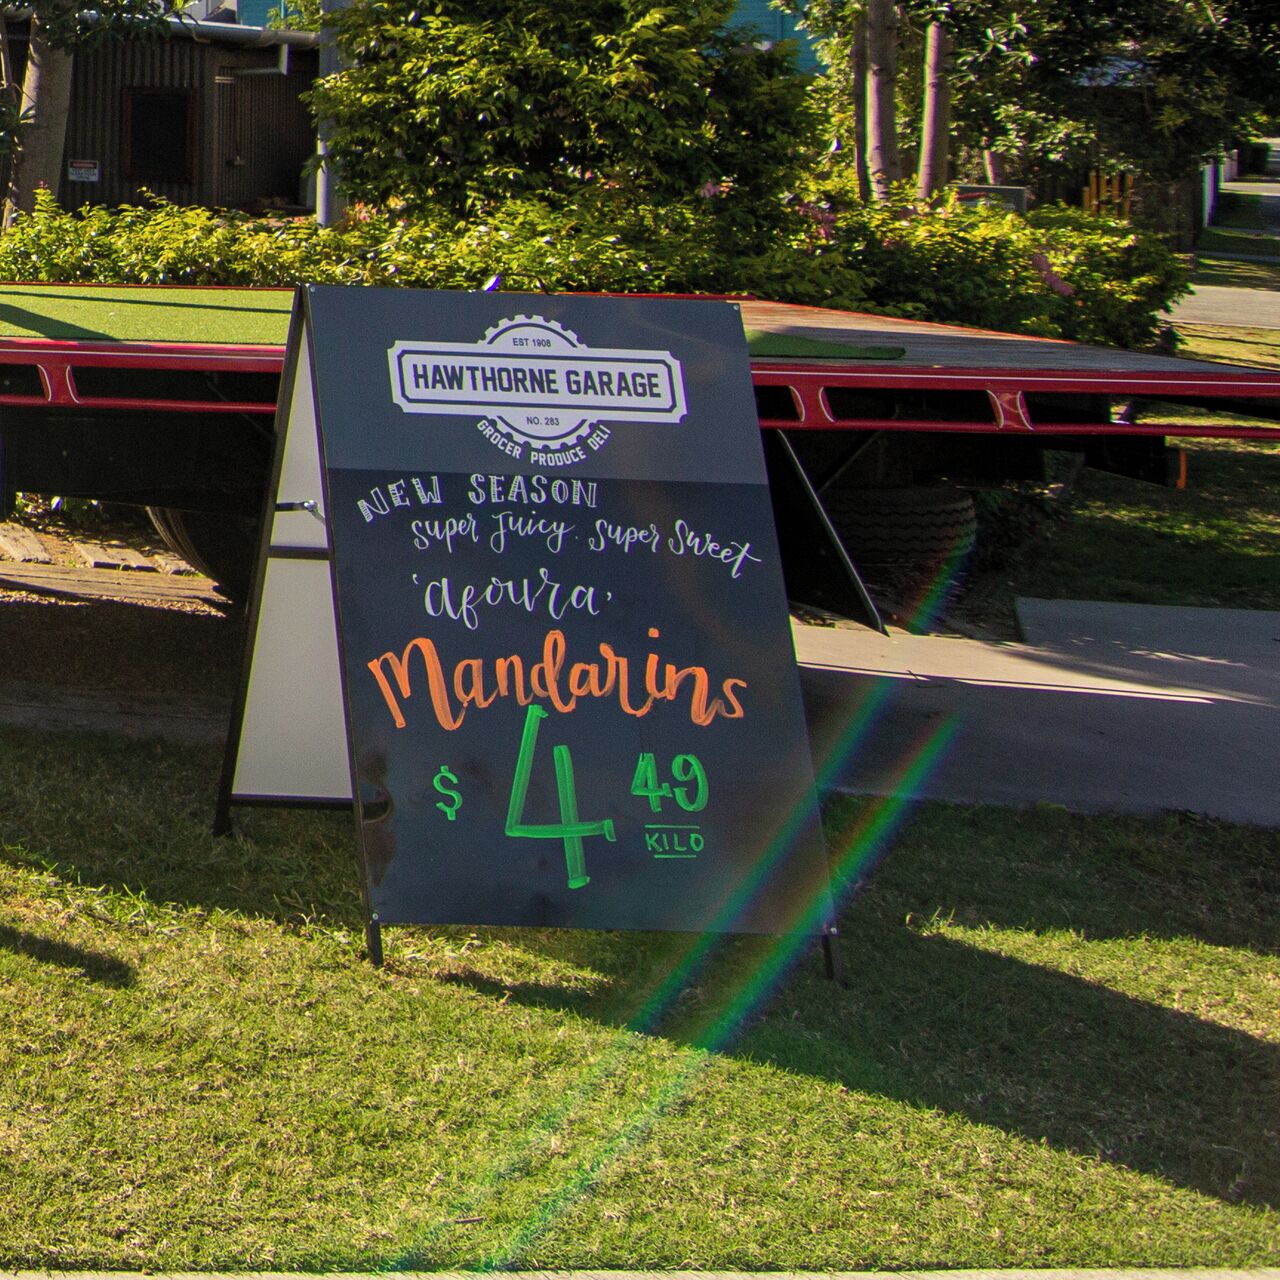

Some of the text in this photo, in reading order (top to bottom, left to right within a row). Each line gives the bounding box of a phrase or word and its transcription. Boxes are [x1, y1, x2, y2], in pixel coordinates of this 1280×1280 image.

[512, 338, 551, 347] EST 1908
[412, 363, 662, 398] HAWTHORNE GARAGE
[476, 419, 611, 466] GROCER PRODUCE DELI
[526, 416, 542, 425] NO.
[357, 473, 598, 522] NEW SEASON
[589, 520, 660, 553] Super
[668, 520, 762, 578] Sweet
[368, 628, 747, 731] Mandarins
[432, 704, 710, 889] $ 4 49
[644, 831, 705, 853] KILO
